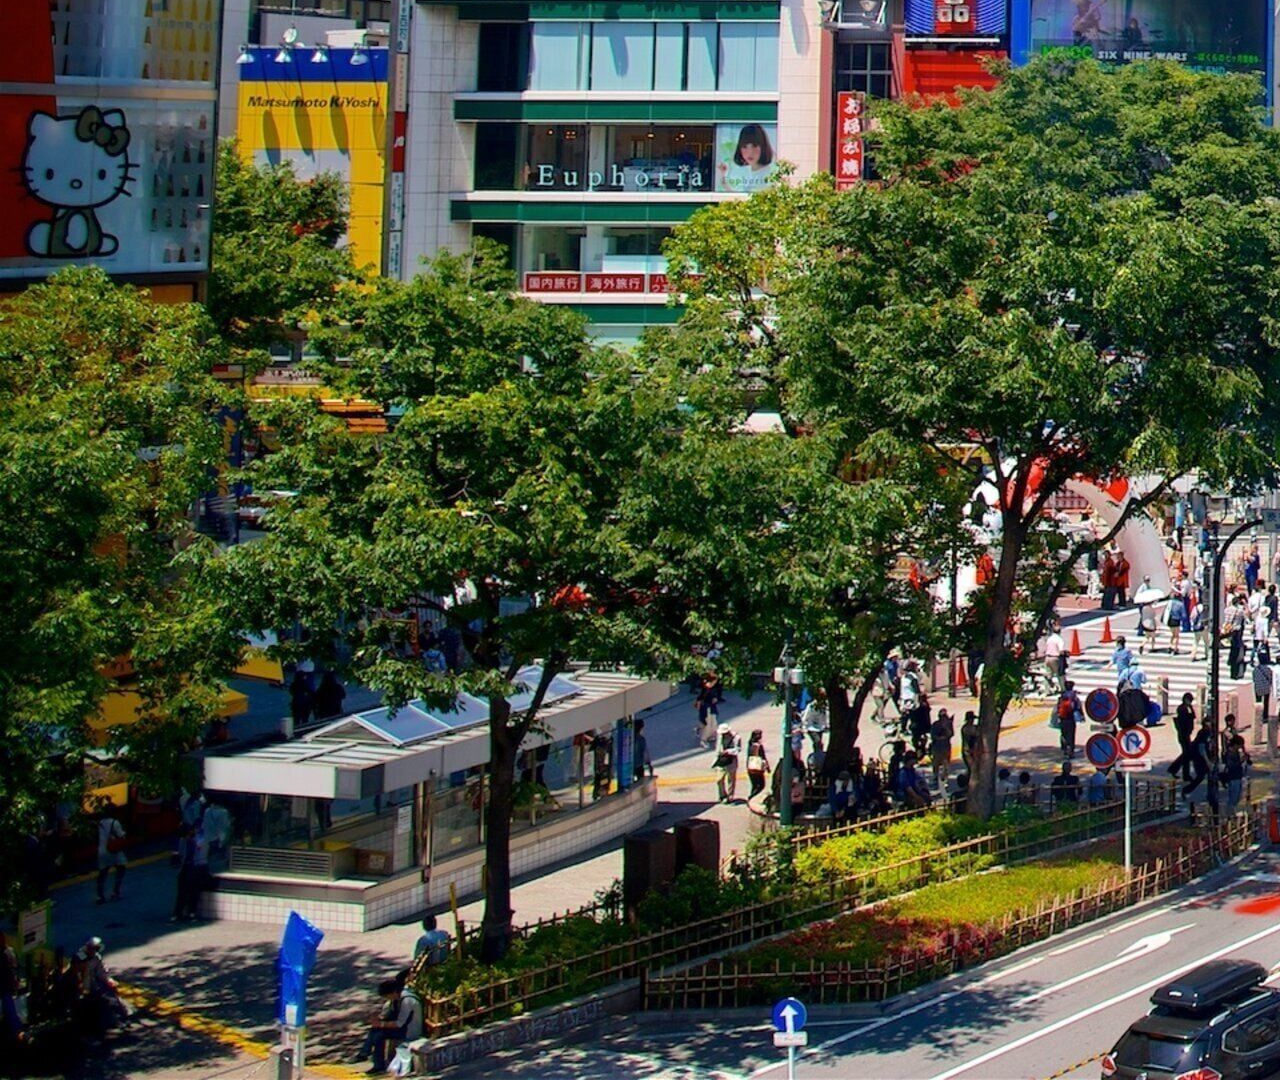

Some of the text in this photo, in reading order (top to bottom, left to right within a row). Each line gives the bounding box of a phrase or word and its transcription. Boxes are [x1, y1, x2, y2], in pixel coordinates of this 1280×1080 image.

[1098, 50, 1118, 61] SIX
[1123, 51, 1151, 61] NINE
[1155, 51, 1188, 62] WARS
[248, 95, 381, 109] Matsumoto KiYoshi
[537, 164, 705, 191] Euphoria
[528, 277, 579, 290] 国内旅行
[590, 277, 641, 290] 海外旅行
